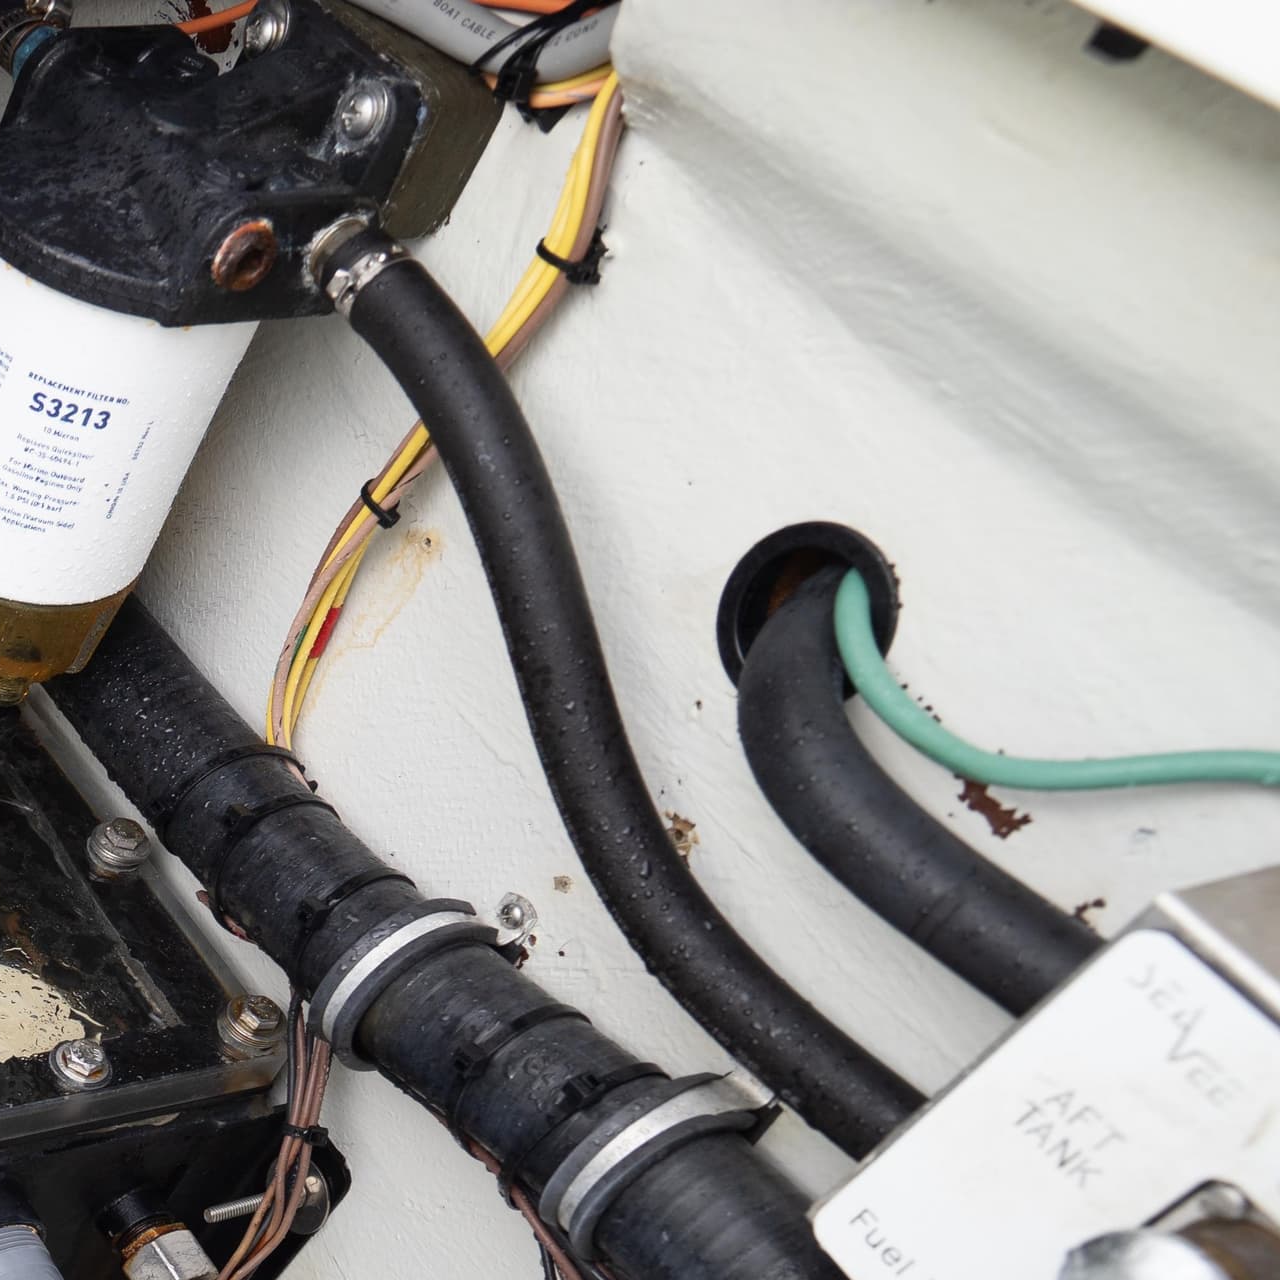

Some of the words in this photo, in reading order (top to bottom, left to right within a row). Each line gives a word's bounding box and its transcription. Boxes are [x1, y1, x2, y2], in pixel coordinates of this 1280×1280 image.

[433, 0, 460, 20] BOAT
[461, 17, 496, 40] CABLE
[28, 371, 85, 396] REPLACEMENT
[86, 391, 115, 403] FILTER
[28, 392, 111, 430] S3213
[53, 429, 80, 441] Micron
[1, 515, 46, 533] Applications
[1043, 1088, 1129, 1151] AFT
[1013, 1099, 1104, 1190] TANK
[848, 1207, 916, 1277] Fuel
